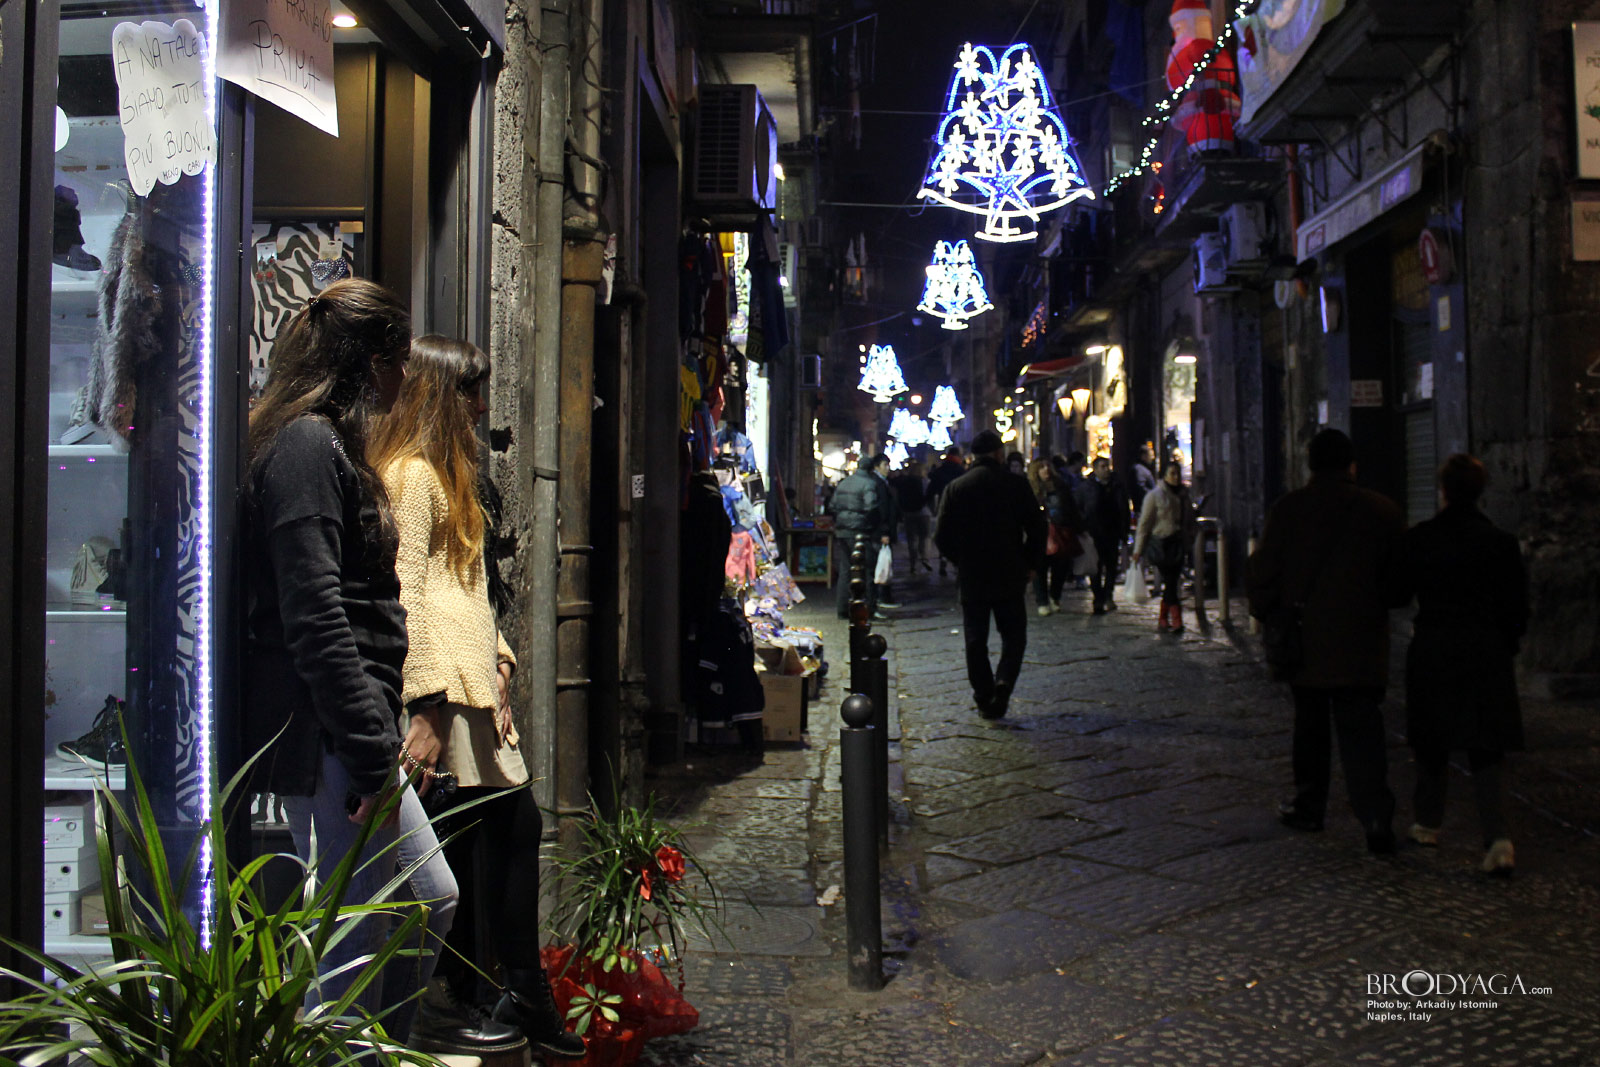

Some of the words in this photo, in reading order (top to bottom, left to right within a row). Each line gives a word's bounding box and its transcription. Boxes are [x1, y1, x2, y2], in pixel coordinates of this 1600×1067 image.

[117, 39, 132, 83] A
[140, 33, 198, 77] NATALE
[248, 19, 321, 94] PRIMA
[123, 87, 165, 125] SIAMO
[162, 165, 179, 181] MENO
